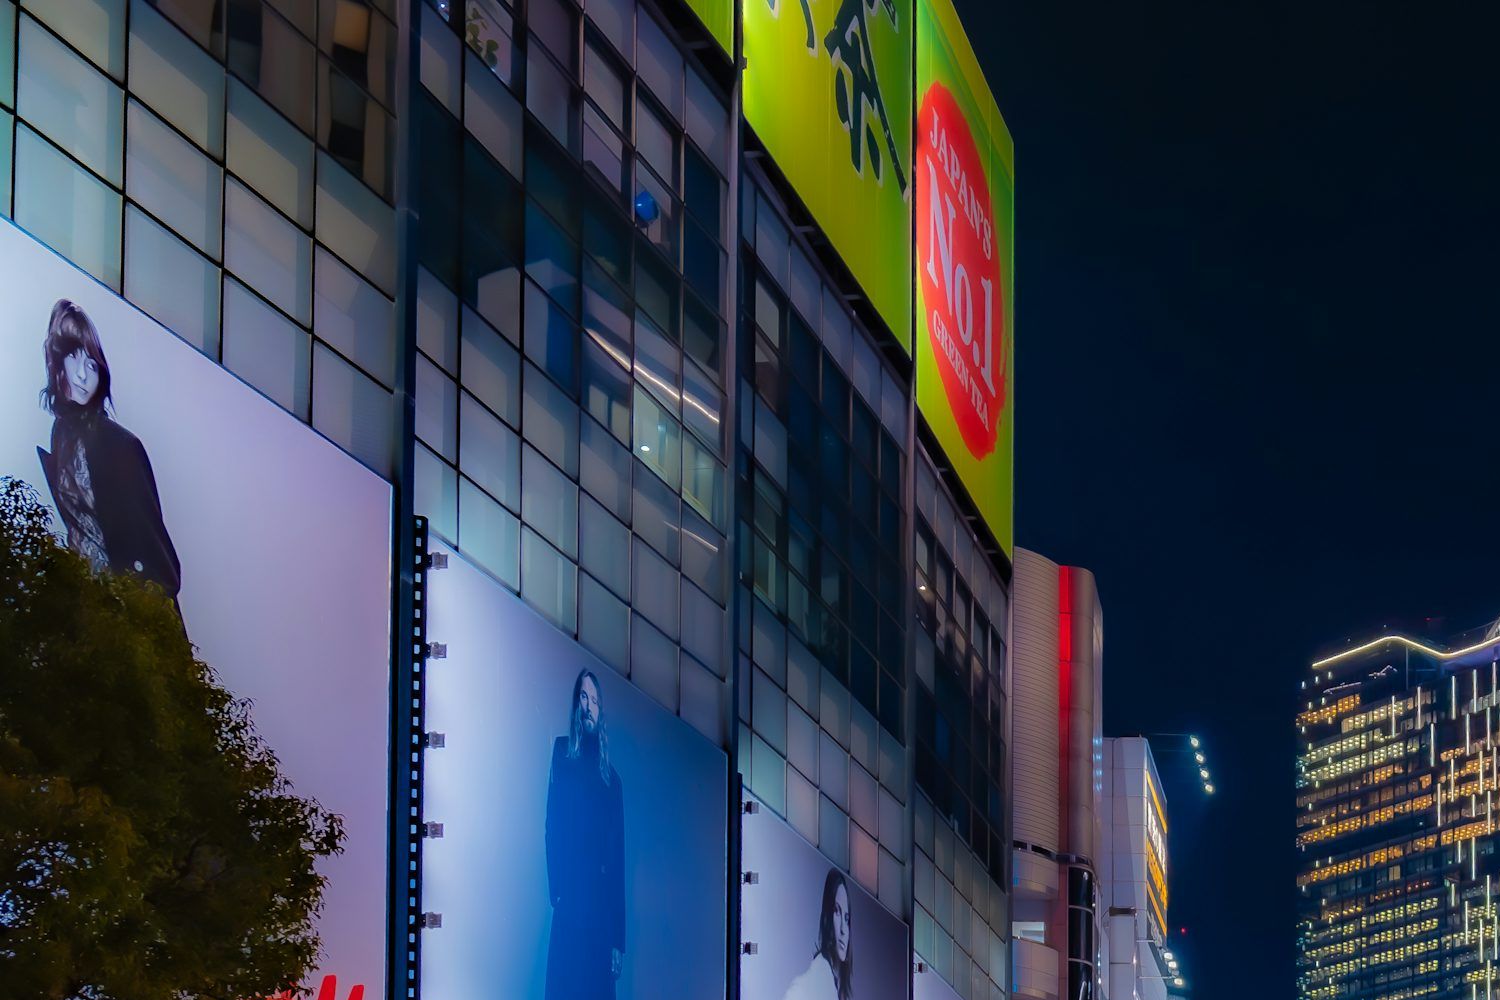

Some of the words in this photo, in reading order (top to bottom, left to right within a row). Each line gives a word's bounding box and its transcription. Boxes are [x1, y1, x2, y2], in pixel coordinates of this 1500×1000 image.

[928, 106, 992, 260] JAPAN'S
[932, 309, 969, 393] GREEN
[969, 376, 990, 432] TEA
